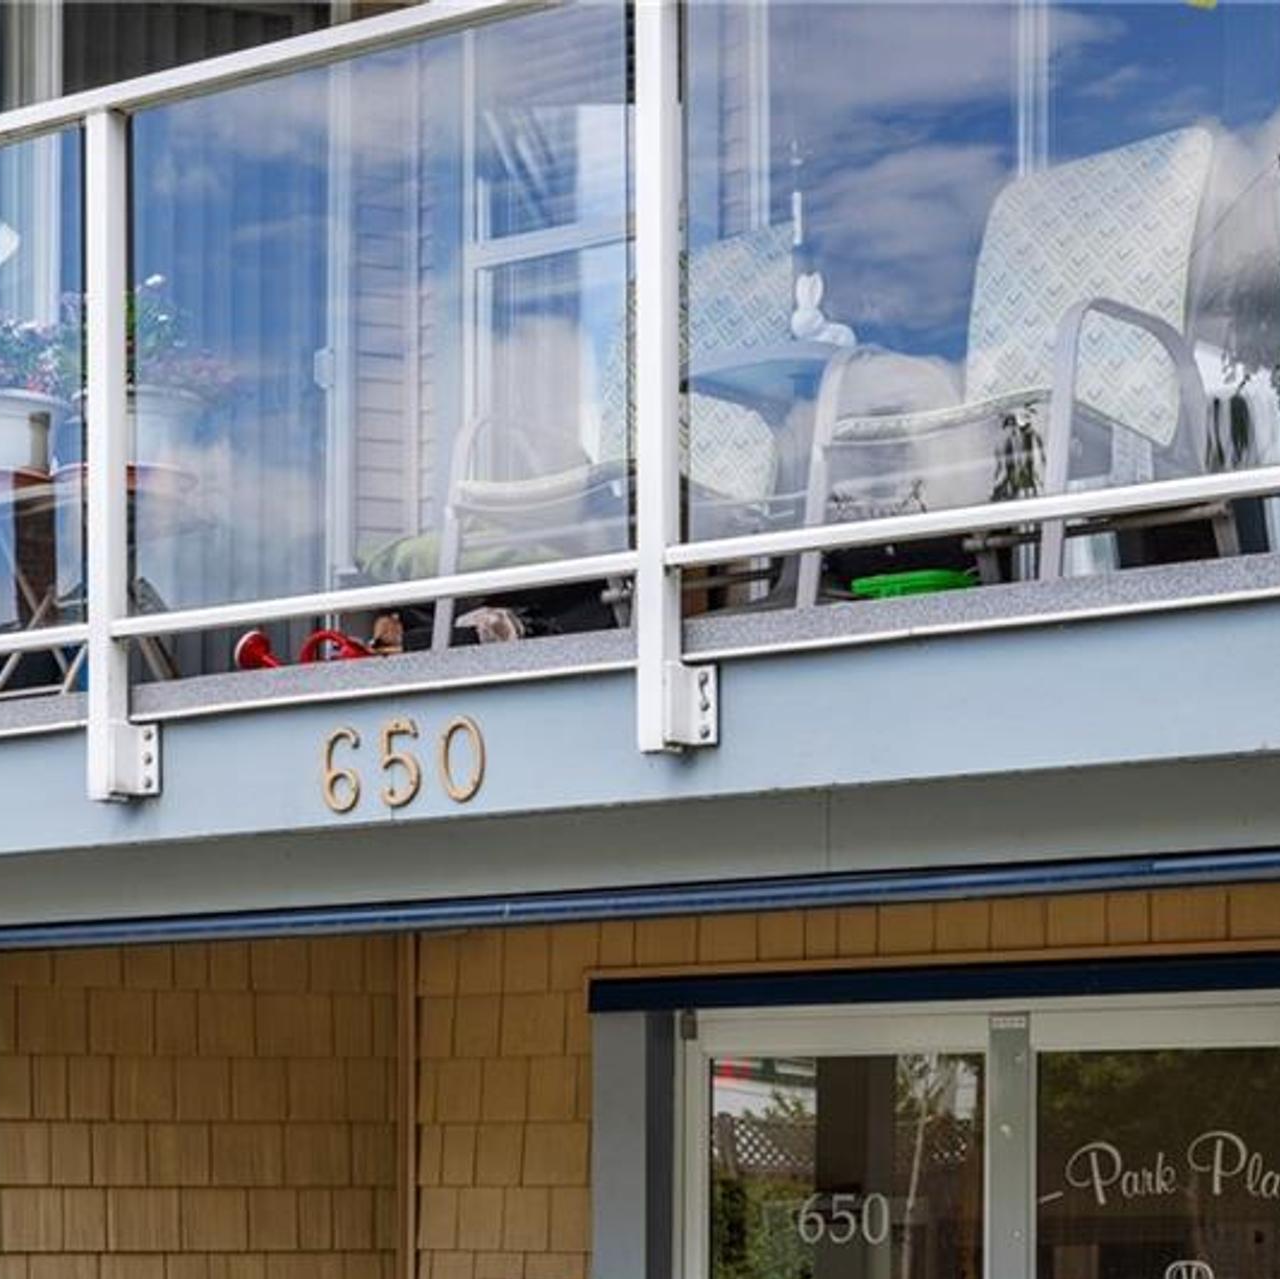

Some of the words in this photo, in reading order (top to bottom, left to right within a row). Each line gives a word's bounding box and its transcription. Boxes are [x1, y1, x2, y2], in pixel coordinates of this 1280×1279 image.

[322, 713, 486, 815] 650
[1065, 1141, 1176, 1205] Park
[799, 1193, 889, 1244] 650
